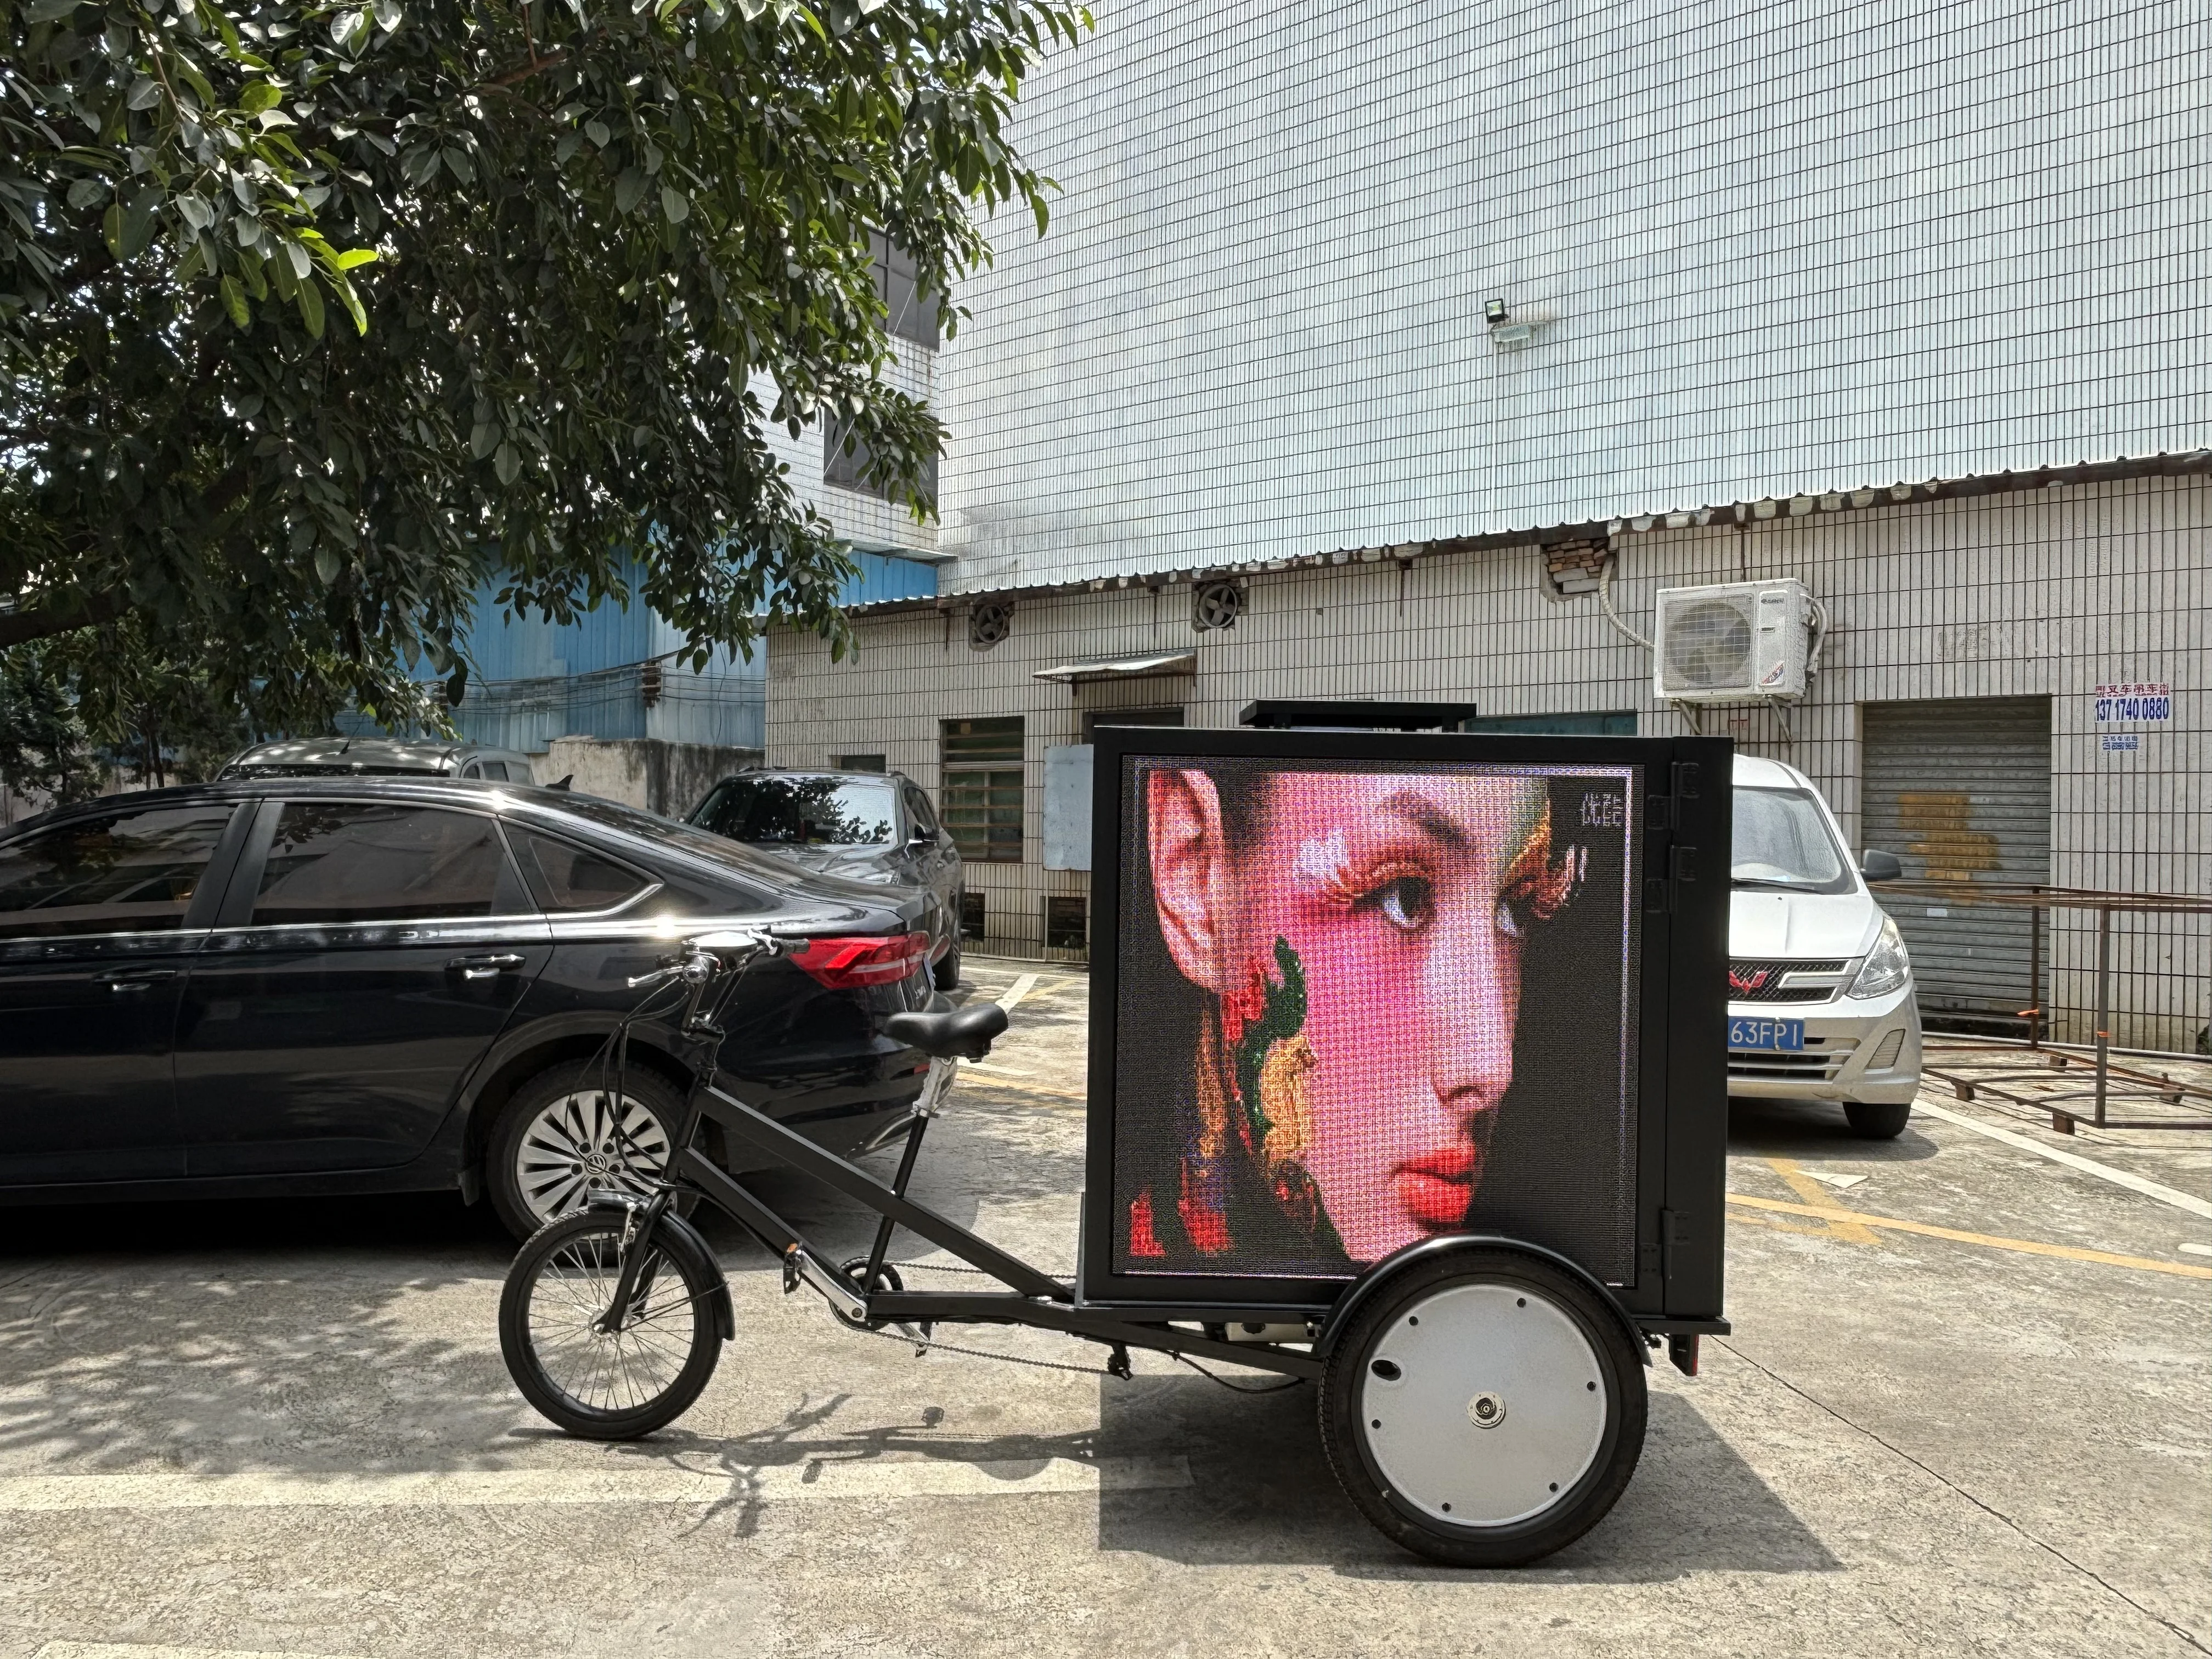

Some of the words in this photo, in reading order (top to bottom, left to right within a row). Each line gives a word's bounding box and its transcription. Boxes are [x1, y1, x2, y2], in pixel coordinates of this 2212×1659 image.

[2096, 699, 2112, 721] 137
[2115, 698, 2139, 720] 1740
[2142, 697, 2169, 720] 0880
